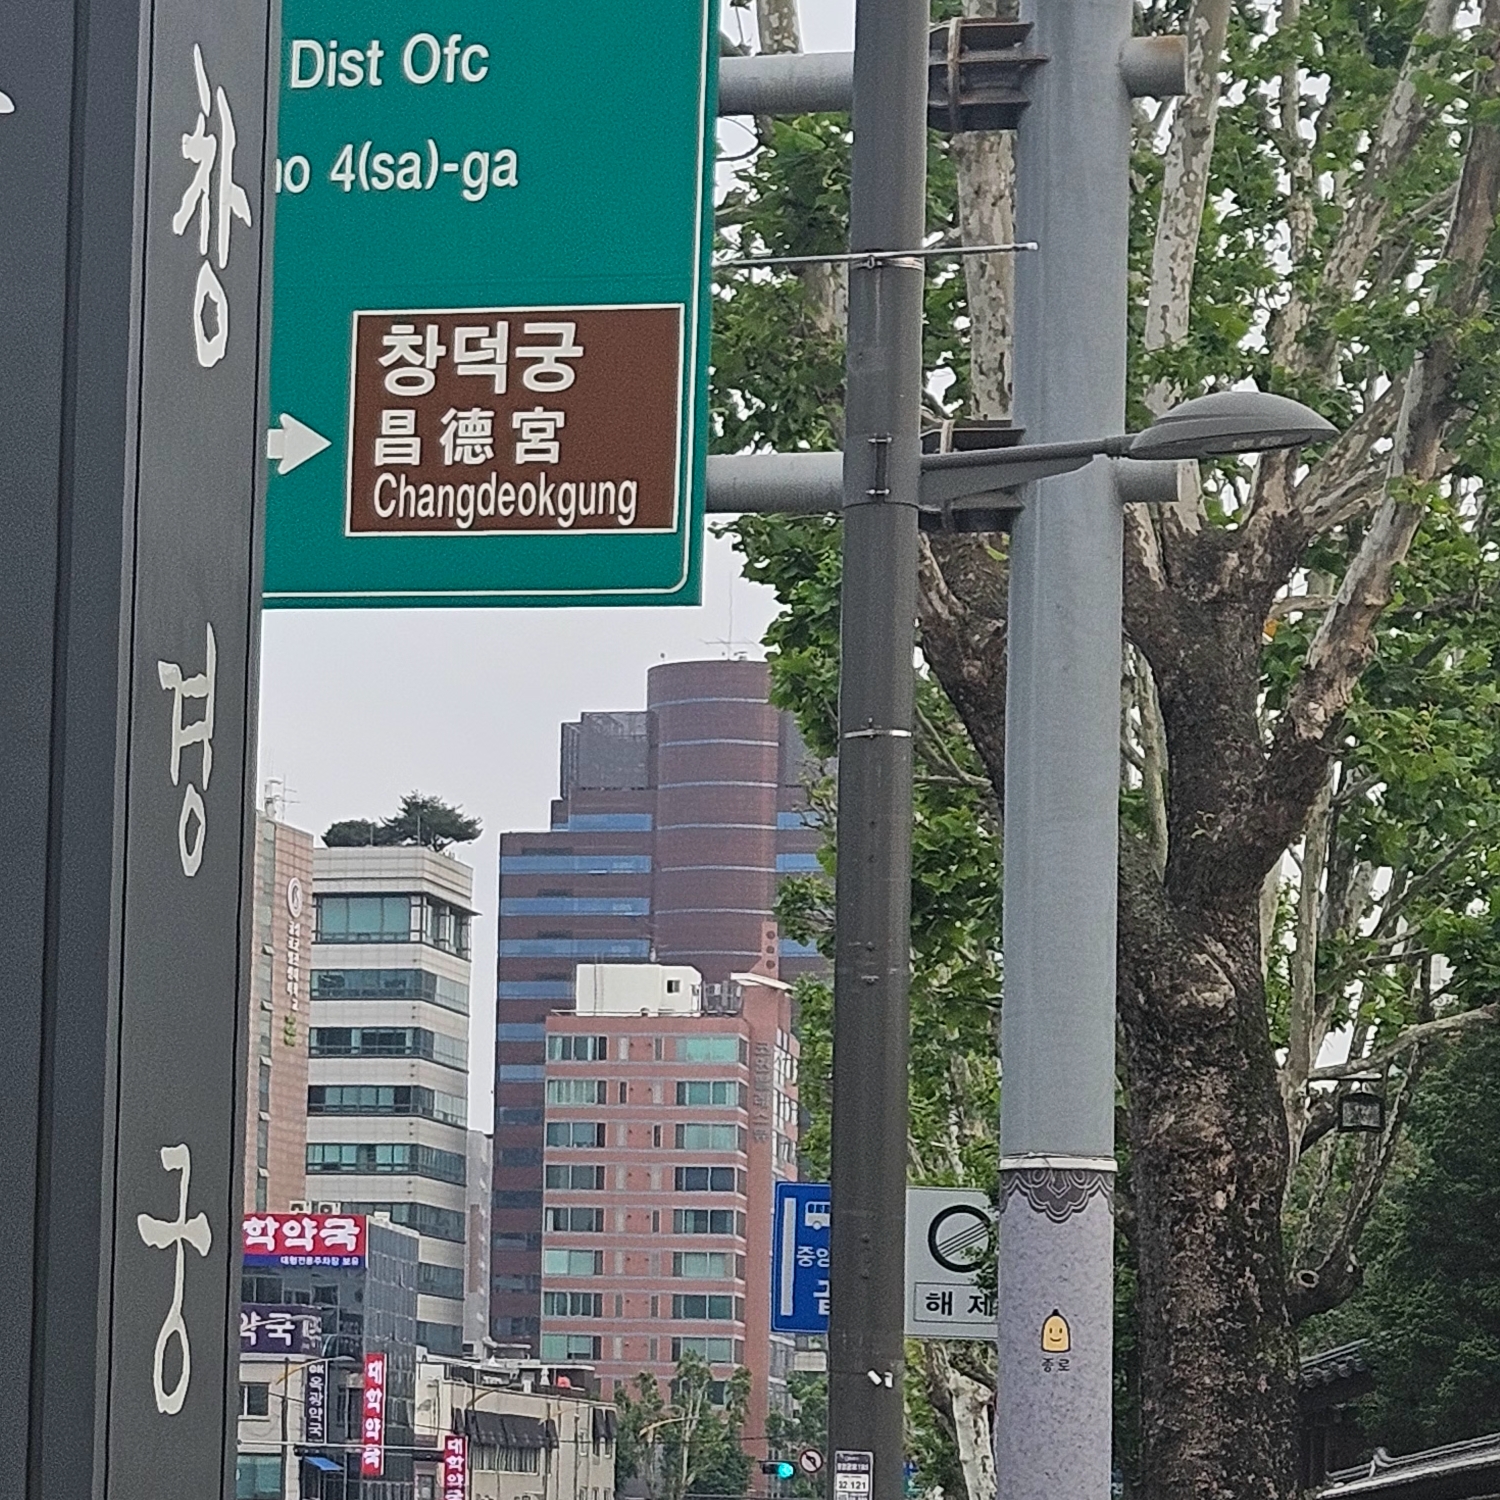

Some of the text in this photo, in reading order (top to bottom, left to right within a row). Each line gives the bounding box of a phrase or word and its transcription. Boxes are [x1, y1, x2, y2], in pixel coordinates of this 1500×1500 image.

[290, 34, 489, 89] Dist Ofc
[330, 139, 519, 201] 4(sa)-ga
[378, 321, 584, 397] 창덕궁
[373, 406, 566, 467] 昌德宮
[373, 472, 638, 529] Changdeokgung
[137, 43, 252, 1415] 창경궁
[1041, 1358, 1071, 1373] 종로
